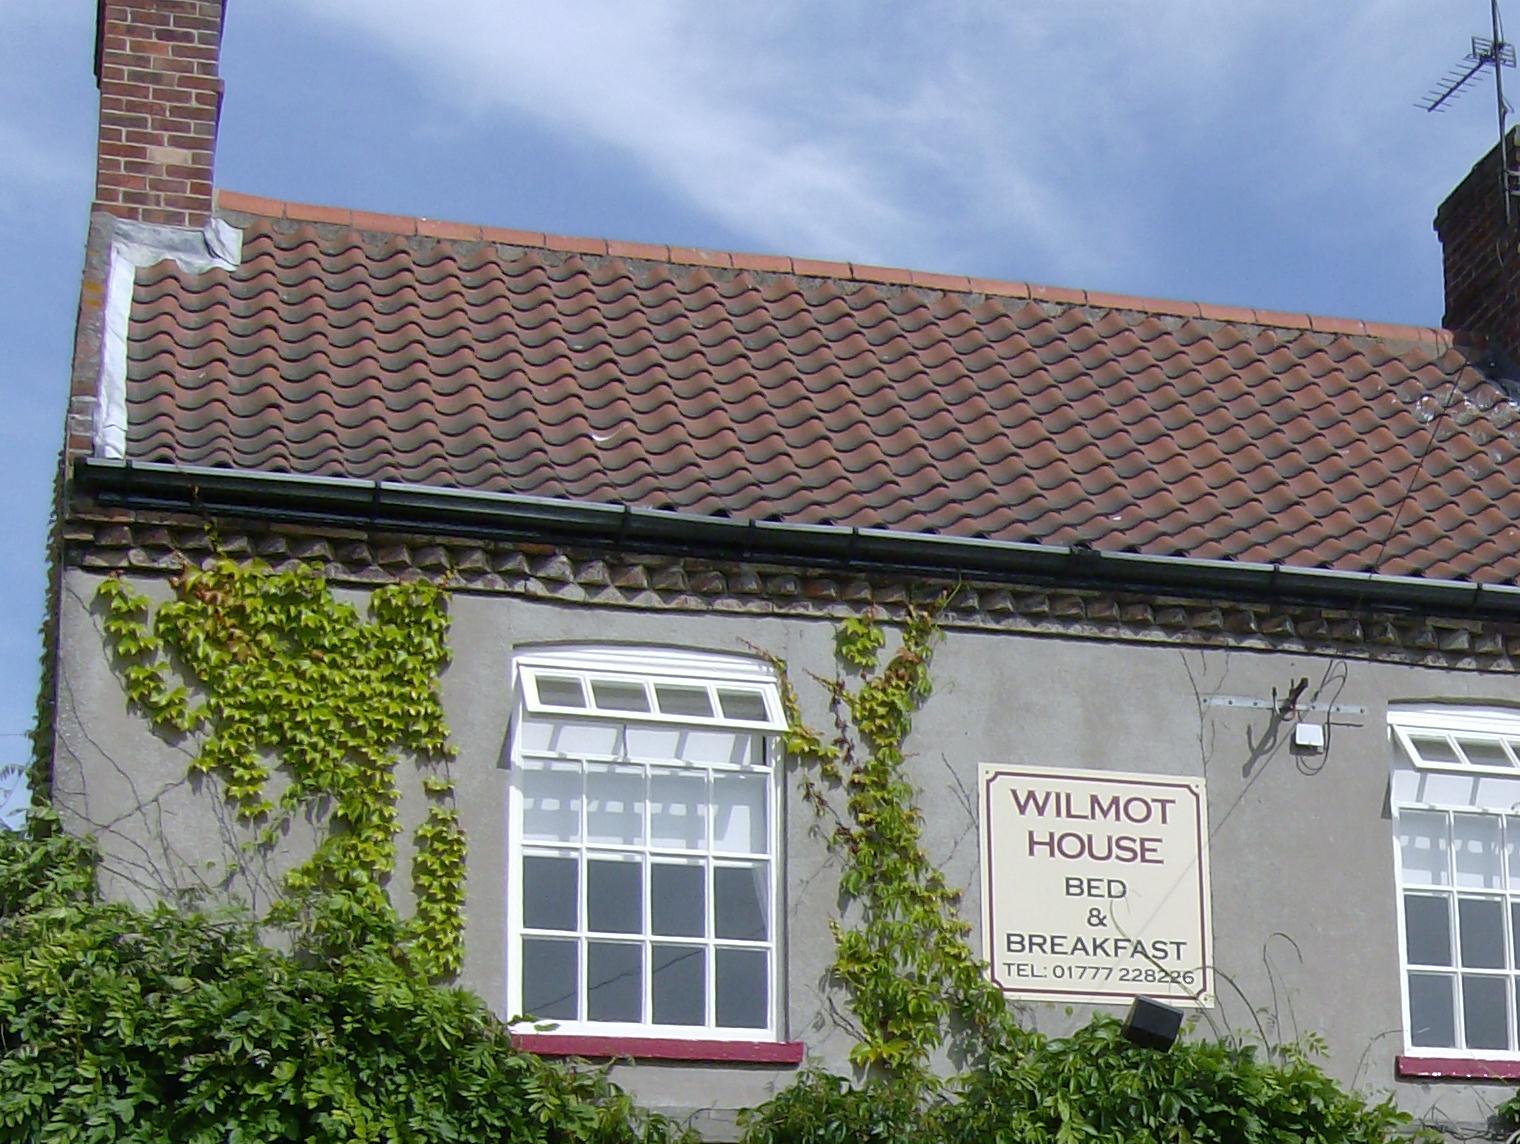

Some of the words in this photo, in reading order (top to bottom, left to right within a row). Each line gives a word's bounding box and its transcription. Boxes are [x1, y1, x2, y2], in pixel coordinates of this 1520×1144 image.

[1010, 788, 1176, 825] WILMOT
[1028, 830, 1164, 865] HOUSE
[1065, 877, 1127, 899] BED
[1087, 907, 1108, 928] &
[1005, 933, 1187, 961] BREAKFAST
[1003, 962, 1047, 978] TEL:
[1052, 965, 1113, 981] 01777
[1118, 968, 1195, 985] 228226
